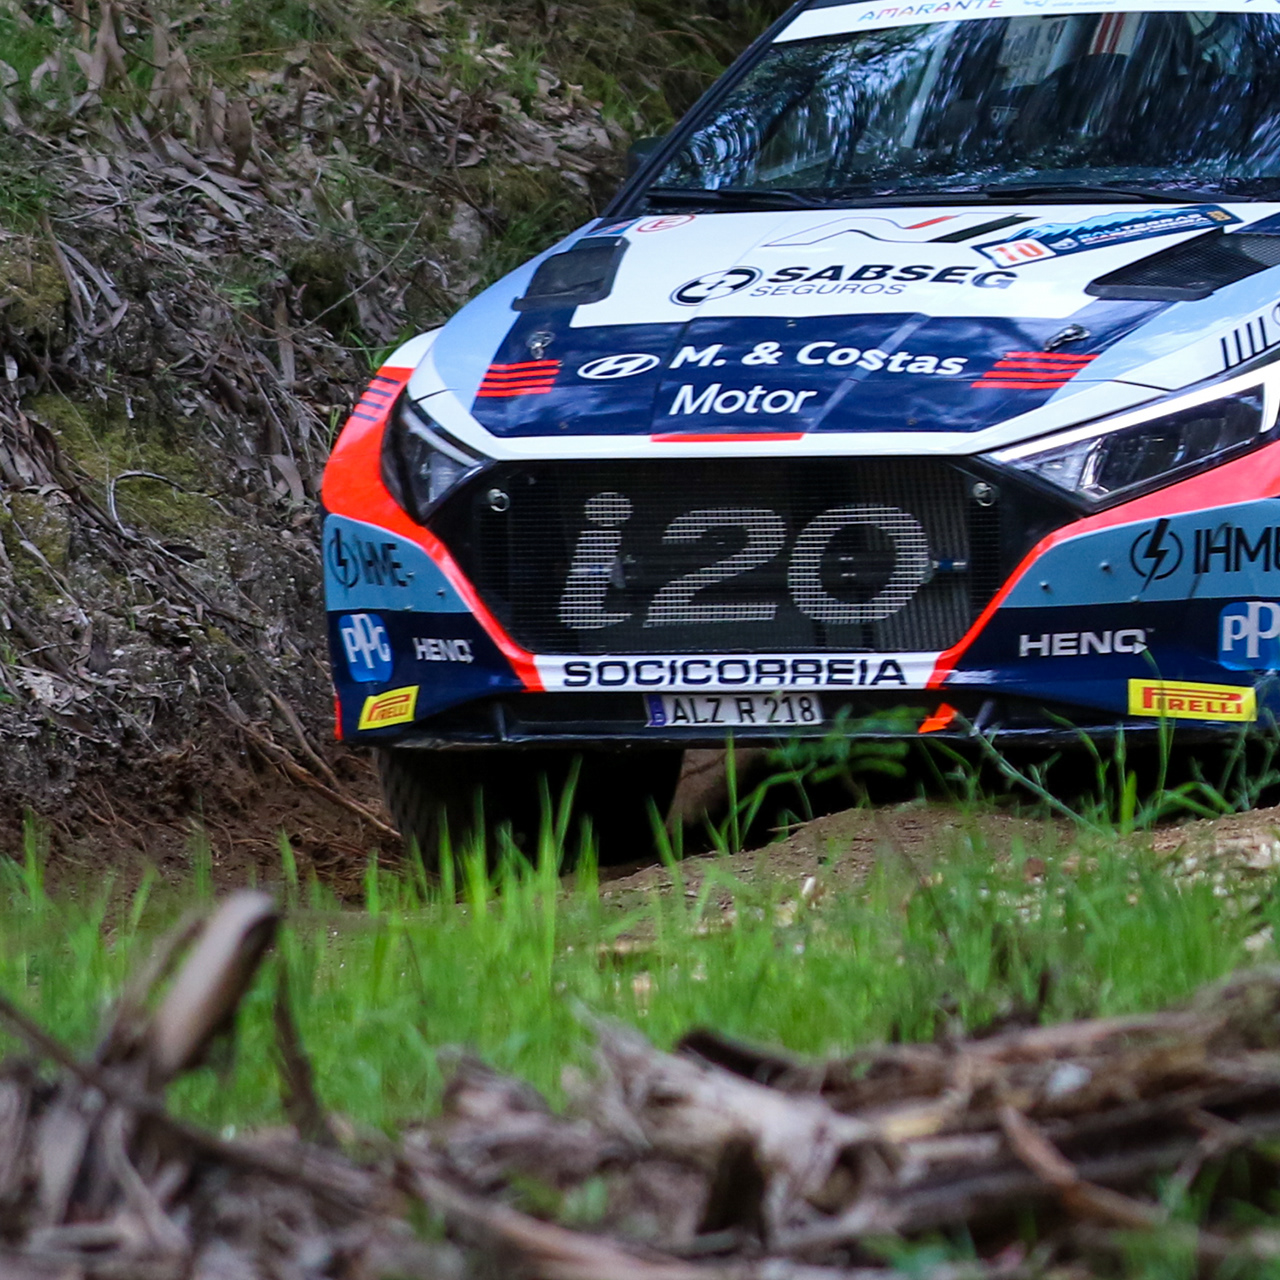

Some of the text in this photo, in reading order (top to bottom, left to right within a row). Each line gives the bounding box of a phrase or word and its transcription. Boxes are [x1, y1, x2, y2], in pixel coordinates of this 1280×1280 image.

[993, 241, 1045, 263] 10
[749, 282, 909, 298] SEGUROS
[768, 263, 1020, 291] SABSEG
[668, 341, 970, 377] M. & Costas
[668, 383, 818, 416] Motor
[557, 491, 930, 631] i20
[341, 613, 392, 669] PPG
[563, 658, 908, 688] SOCICORREIA
[366, 694, 411, 722] PIRELLI
[672, 696, 816, 724] ALZ R 218
[1142, 686, 1243, 715] PIRELLI
